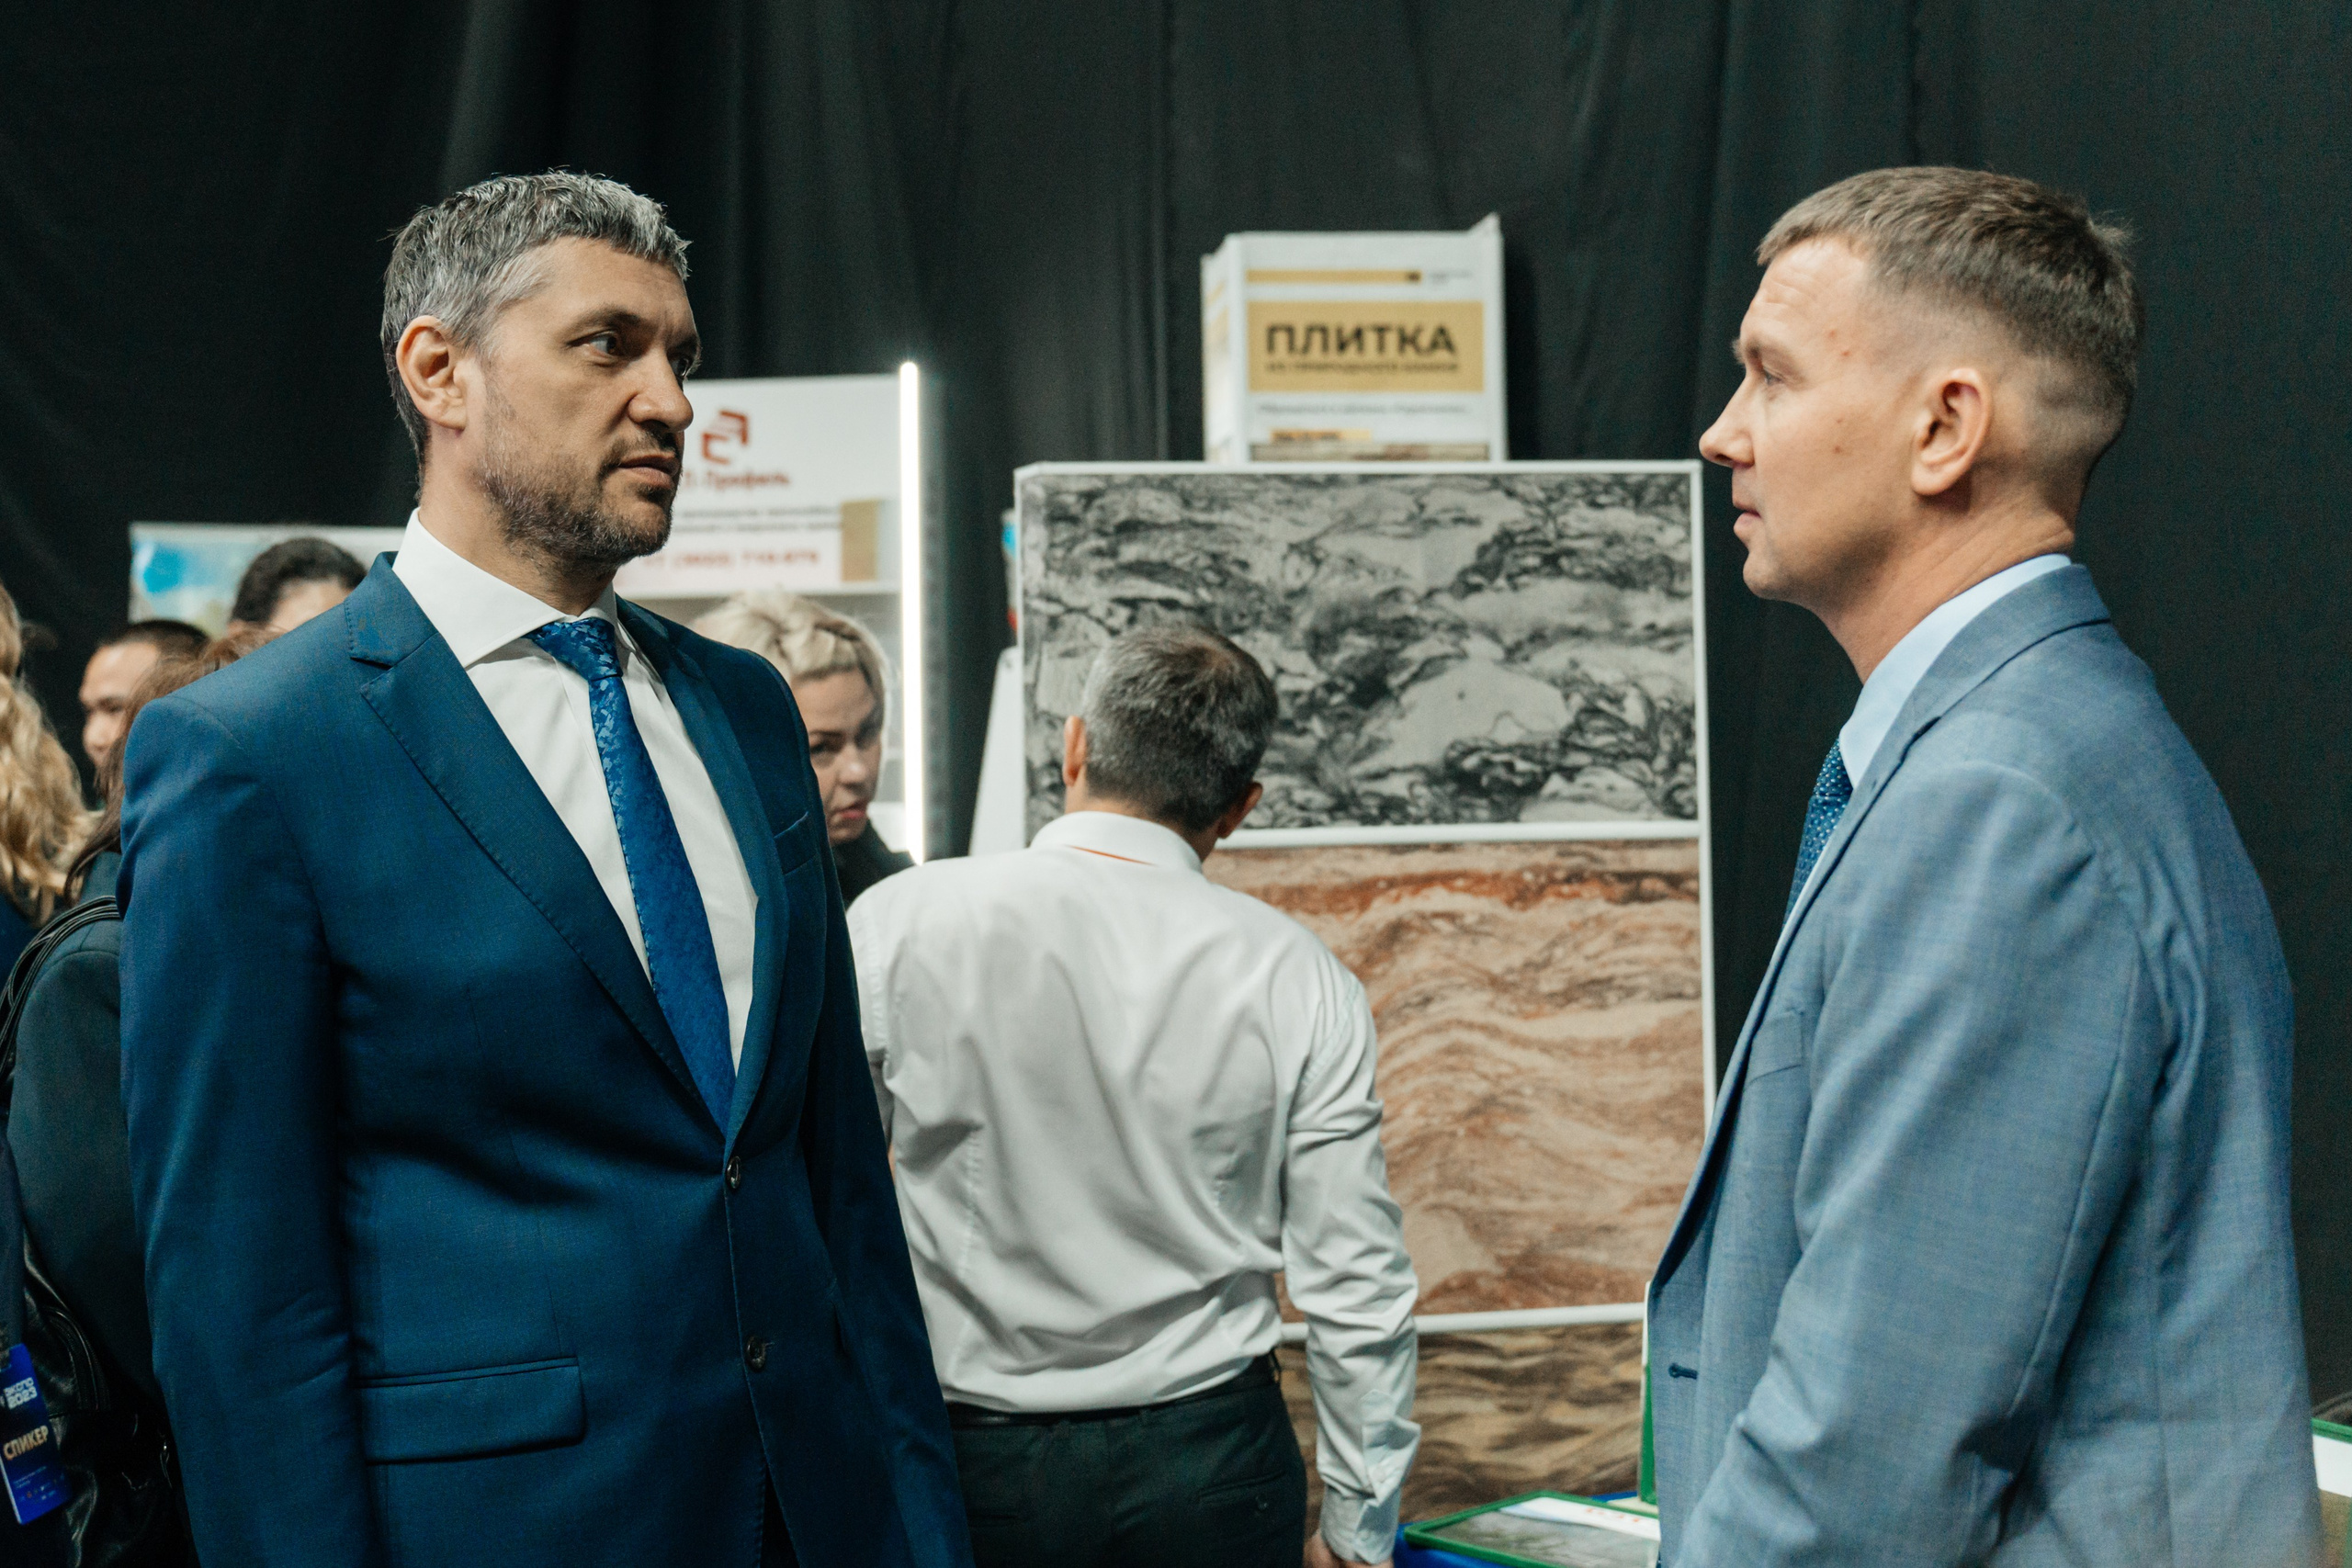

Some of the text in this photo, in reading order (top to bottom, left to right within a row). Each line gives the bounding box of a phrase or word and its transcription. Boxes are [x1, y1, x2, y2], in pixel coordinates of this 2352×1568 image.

[1265, 323, 1456, 355] ПЛИТКА
[7, 1386, 38, 1409] 2023
[3, 1425, 49, 1461] СПИКЕР
